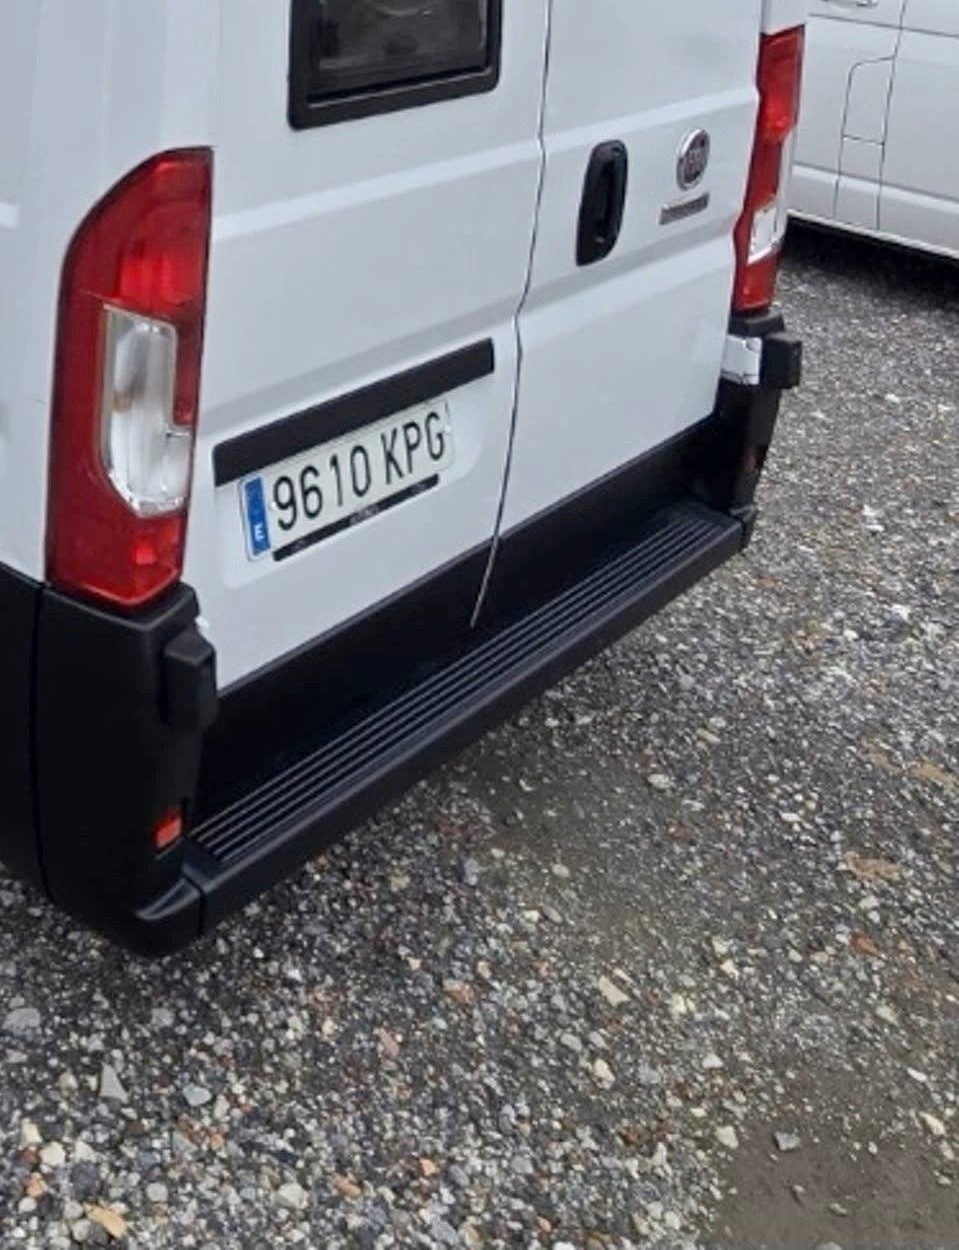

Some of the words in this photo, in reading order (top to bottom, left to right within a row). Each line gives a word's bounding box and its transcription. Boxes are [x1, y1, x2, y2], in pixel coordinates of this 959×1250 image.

[273, 445, 372, 531] 9610
[381, 411, 445, 485] KPG
[253, 523, 264, 542] E
